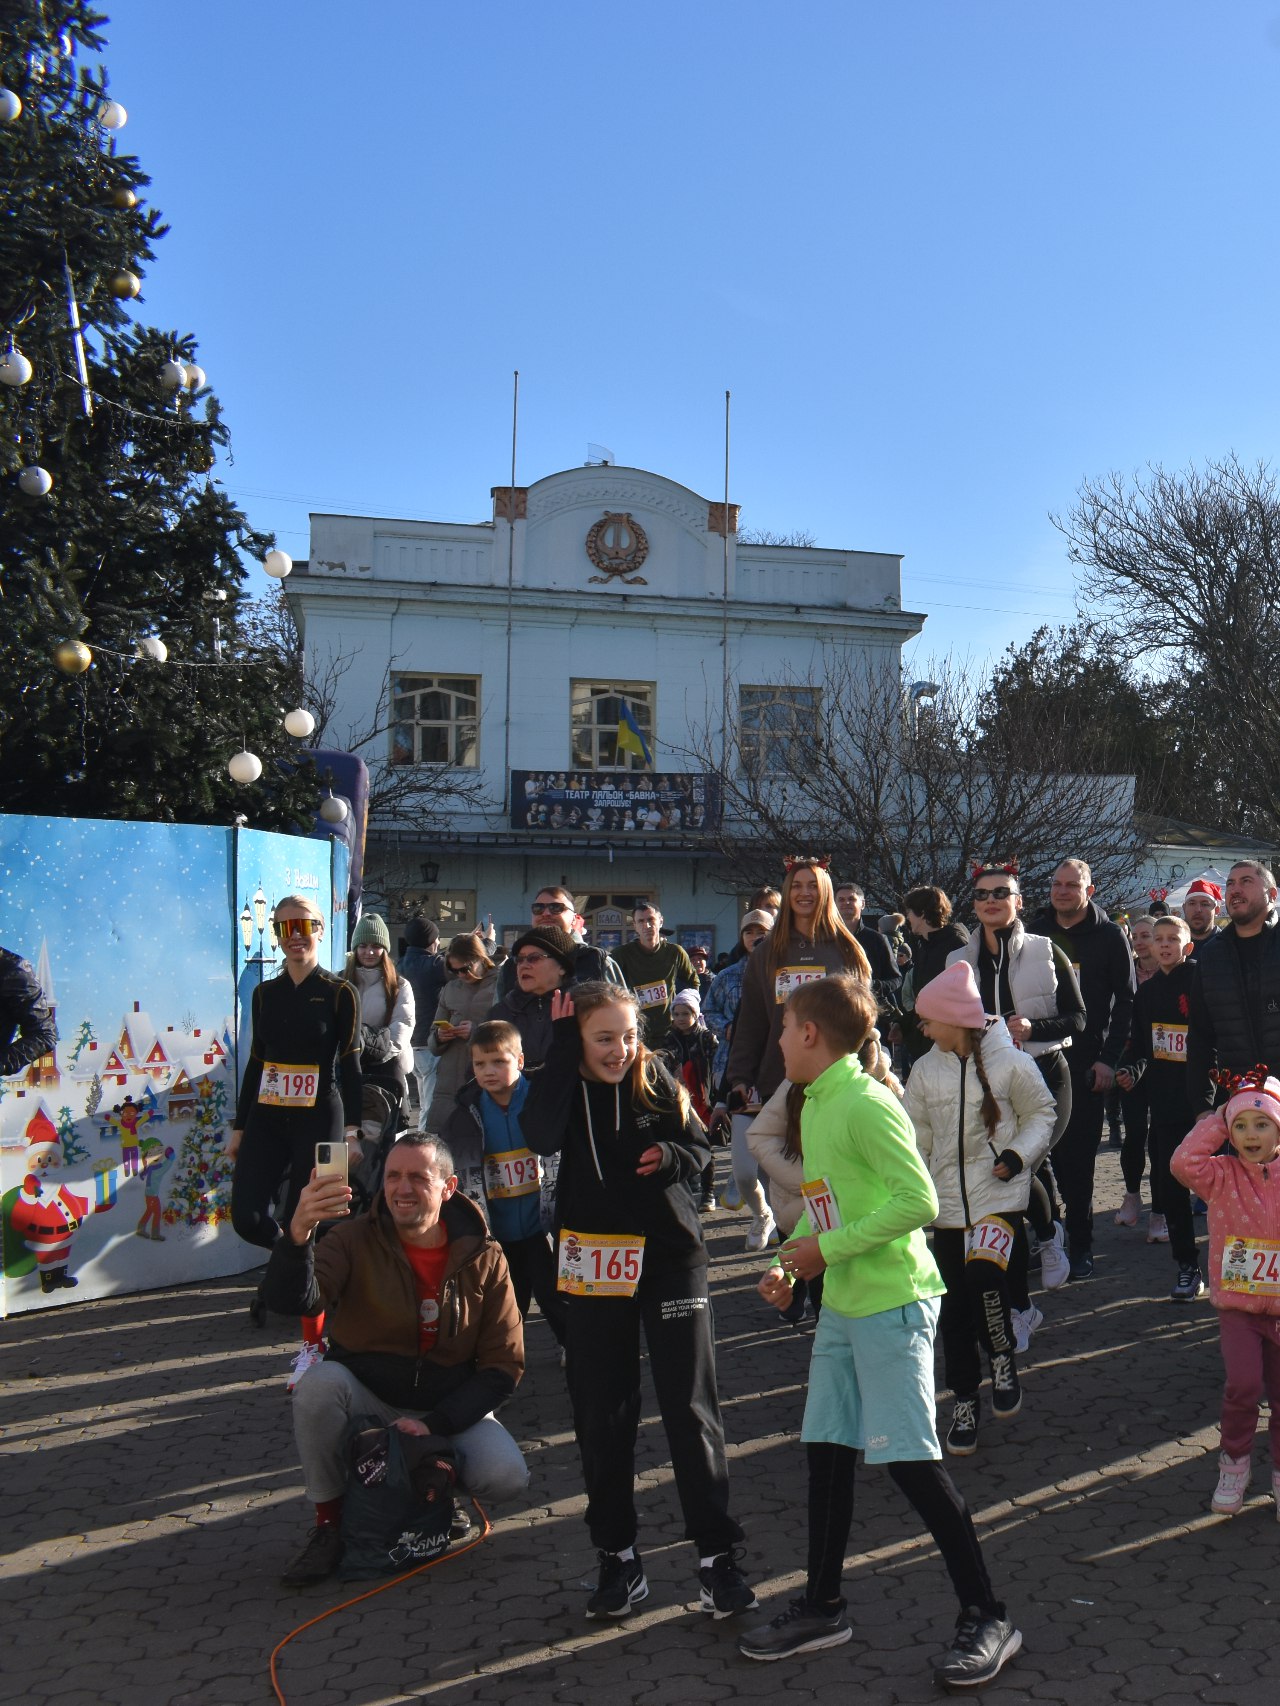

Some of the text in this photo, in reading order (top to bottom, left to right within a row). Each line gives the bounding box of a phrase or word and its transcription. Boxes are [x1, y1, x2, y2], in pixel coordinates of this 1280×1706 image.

[565, 790, 590, 799] ТЕАТР
[592, 790, 623, 799] ЛЯЛЬОК
[599, 914, 621, 924] КАСА
[649, 985, 667, 1000] 138
[282, 1074, 316, 1096] 198
[504, 1157, 539, 1186] 193
[979, 1225, 1010, 1258] 122
[590, 1249, 640, 1281] 165
[982, 1290, 1012, 1351] CHAMPION
